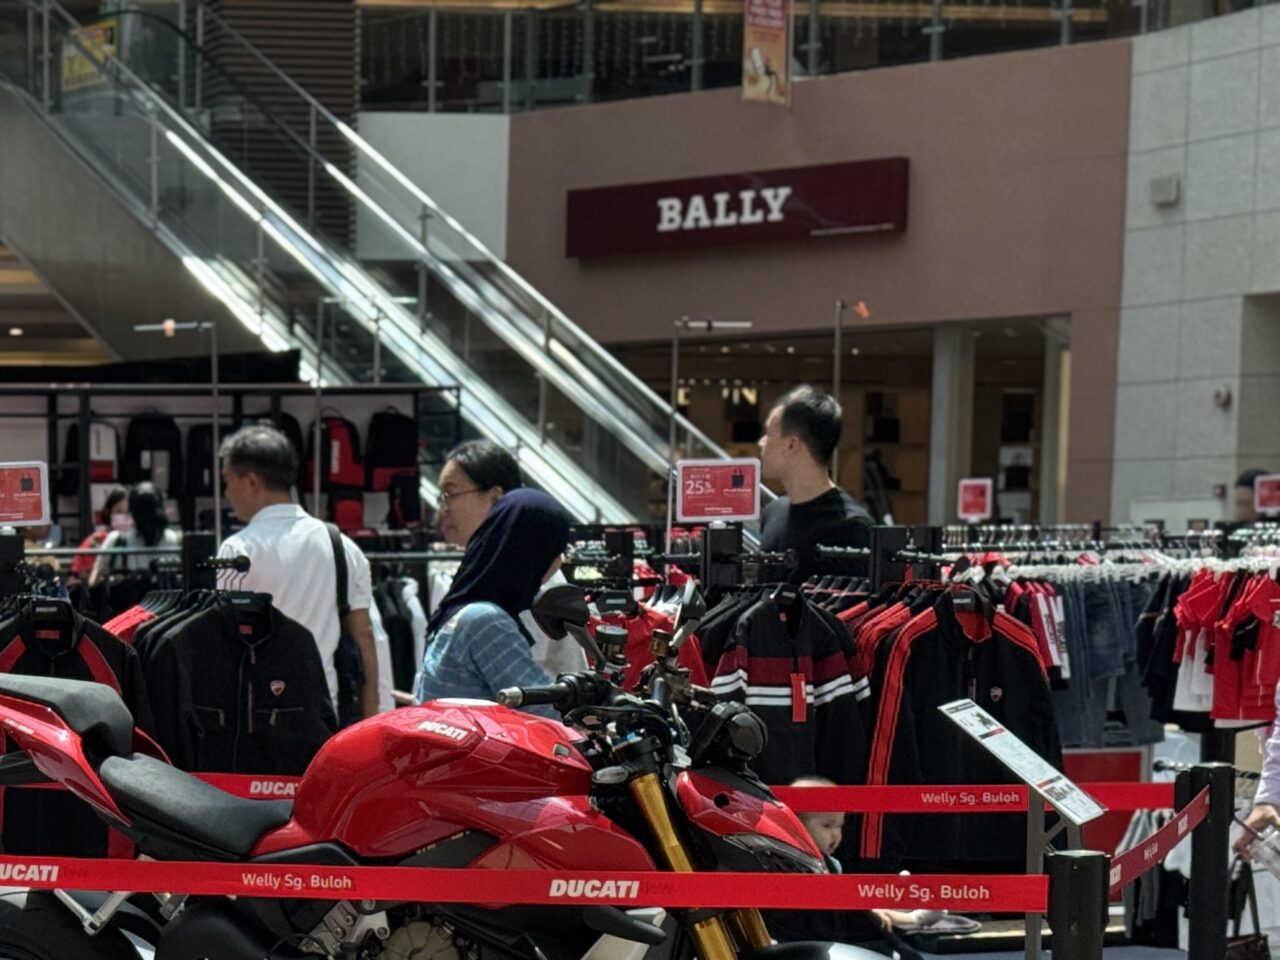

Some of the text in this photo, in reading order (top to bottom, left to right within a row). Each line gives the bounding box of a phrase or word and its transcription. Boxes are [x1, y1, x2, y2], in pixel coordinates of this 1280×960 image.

[657, 186, 792, 232] BALLY
[417, 721, 469, 740] DUCATI
[250, 781, 299, 795] DUCA
[921, 791, 1019, 805] Welly Sg. Buloh
[242, 873, 281, 889] Welly
[285, 874, 306, 890] Sg.
[311, 875, 352, 888] Buloh
[549, 879, 640, 898] DUCATI
[858, 884, 904, 900] Welly
[909, 884, 935, 901] Sg.
[940, 885, 990, 899] Buloh
